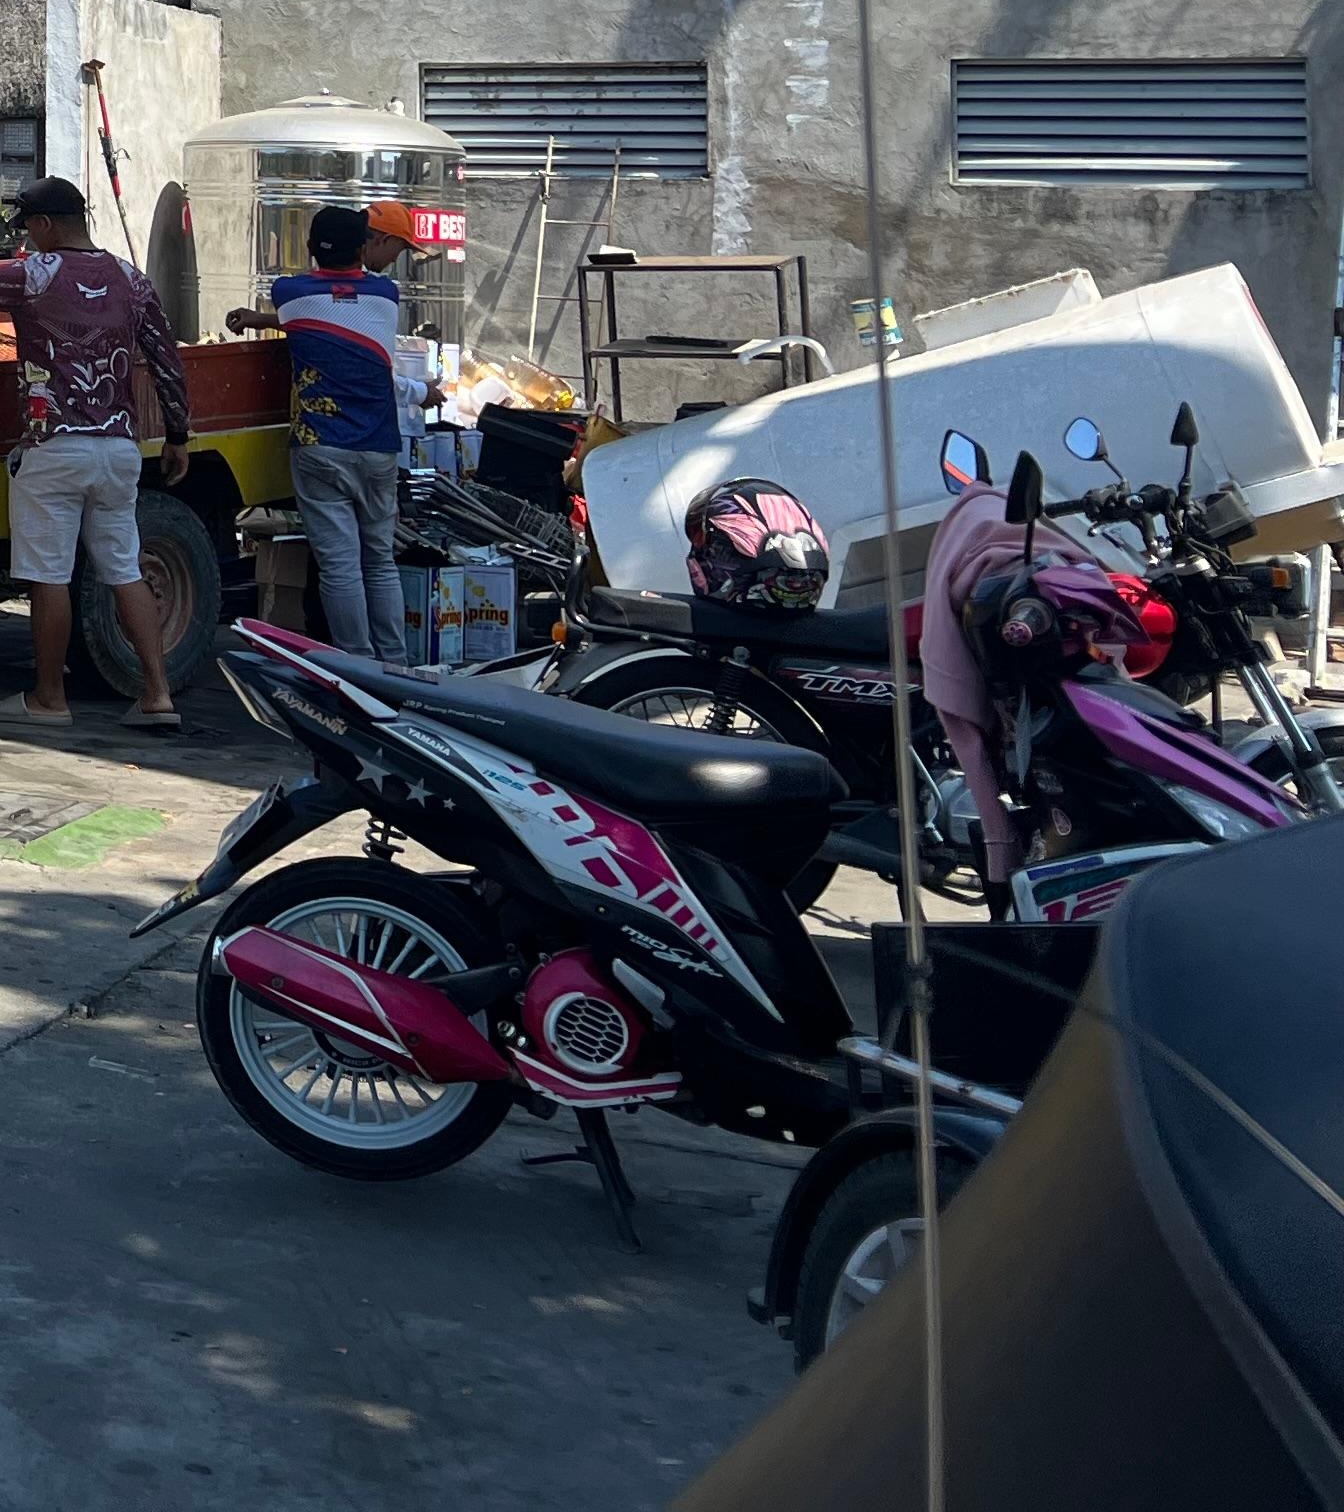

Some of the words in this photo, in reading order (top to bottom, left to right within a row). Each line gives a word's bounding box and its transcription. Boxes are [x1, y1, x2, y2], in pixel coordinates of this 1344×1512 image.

[464, 607, 509, 626] pring
[797, 673, 922, 699] TMX
[408, 727, 451, 757] YAMAHA
